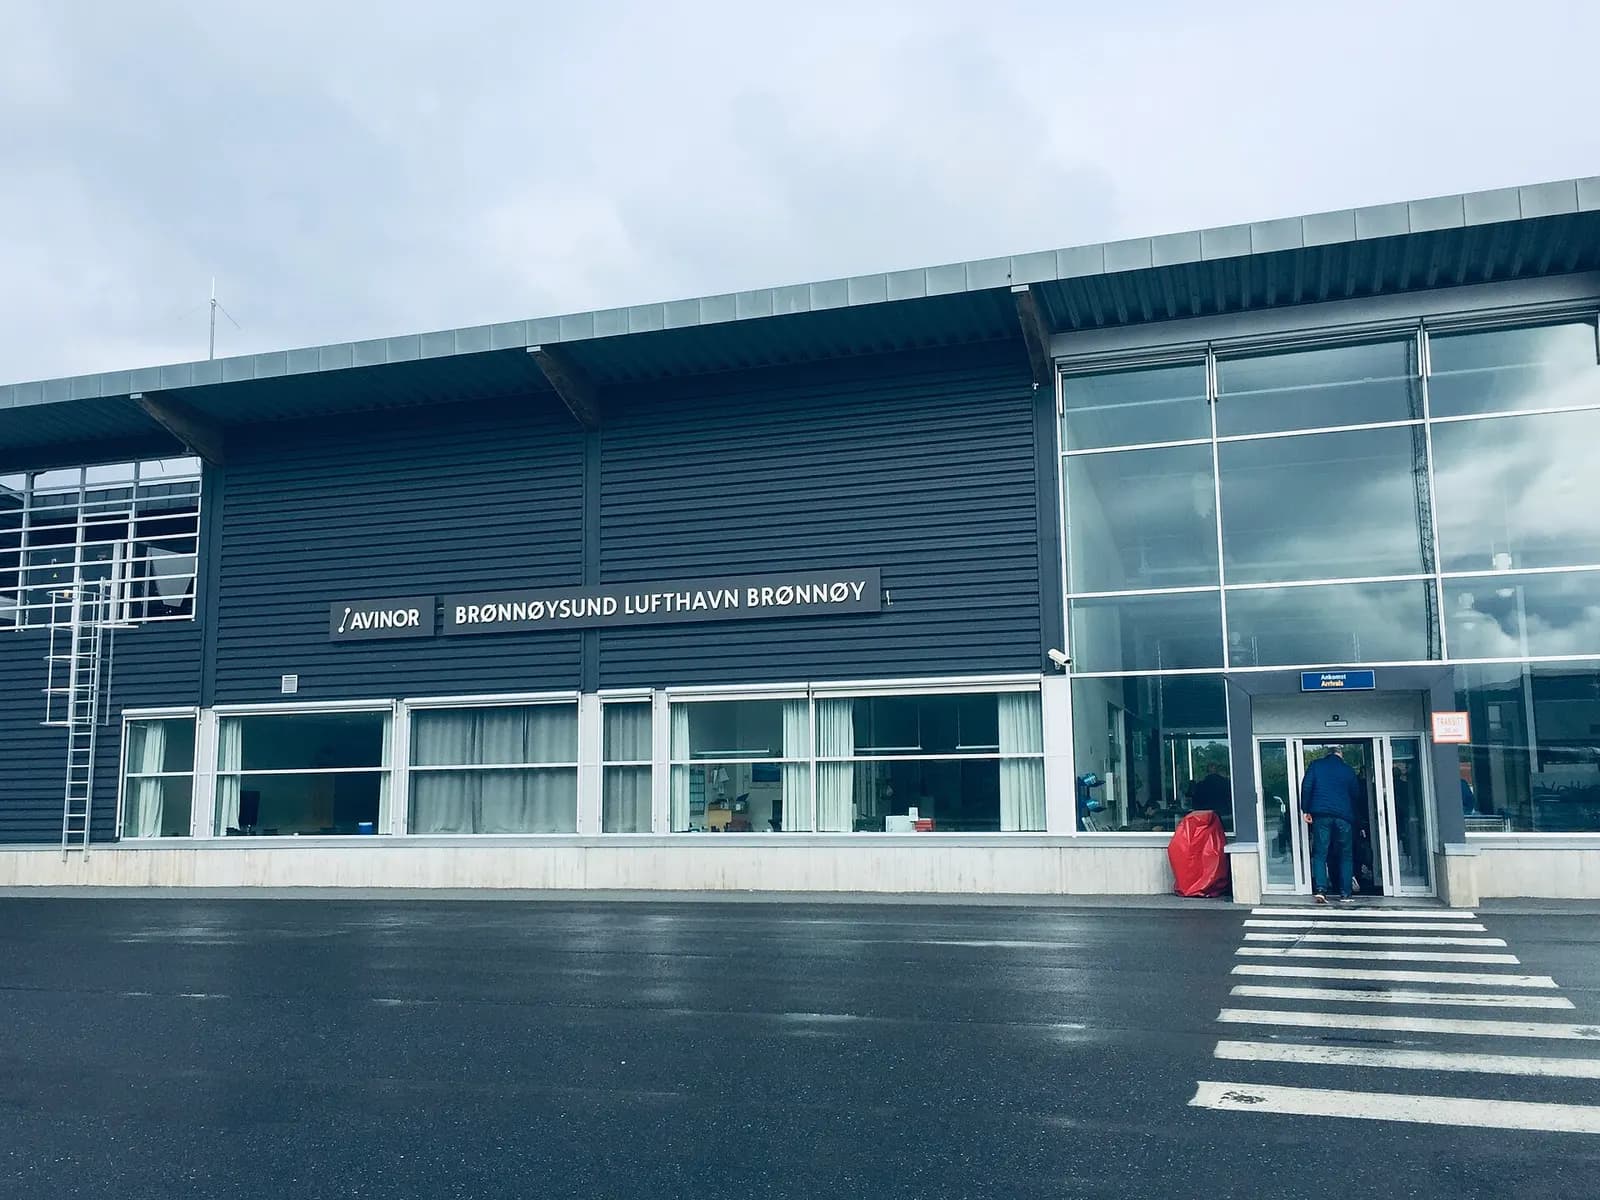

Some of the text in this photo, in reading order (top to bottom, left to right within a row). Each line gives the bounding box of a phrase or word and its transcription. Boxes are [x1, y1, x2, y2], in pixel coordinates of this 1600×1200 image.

[455, 581, 866, 624] BRØNNØYSUND LUFTHAVN BRØNNØY
[350, 608, 420, 630] AVINOR
